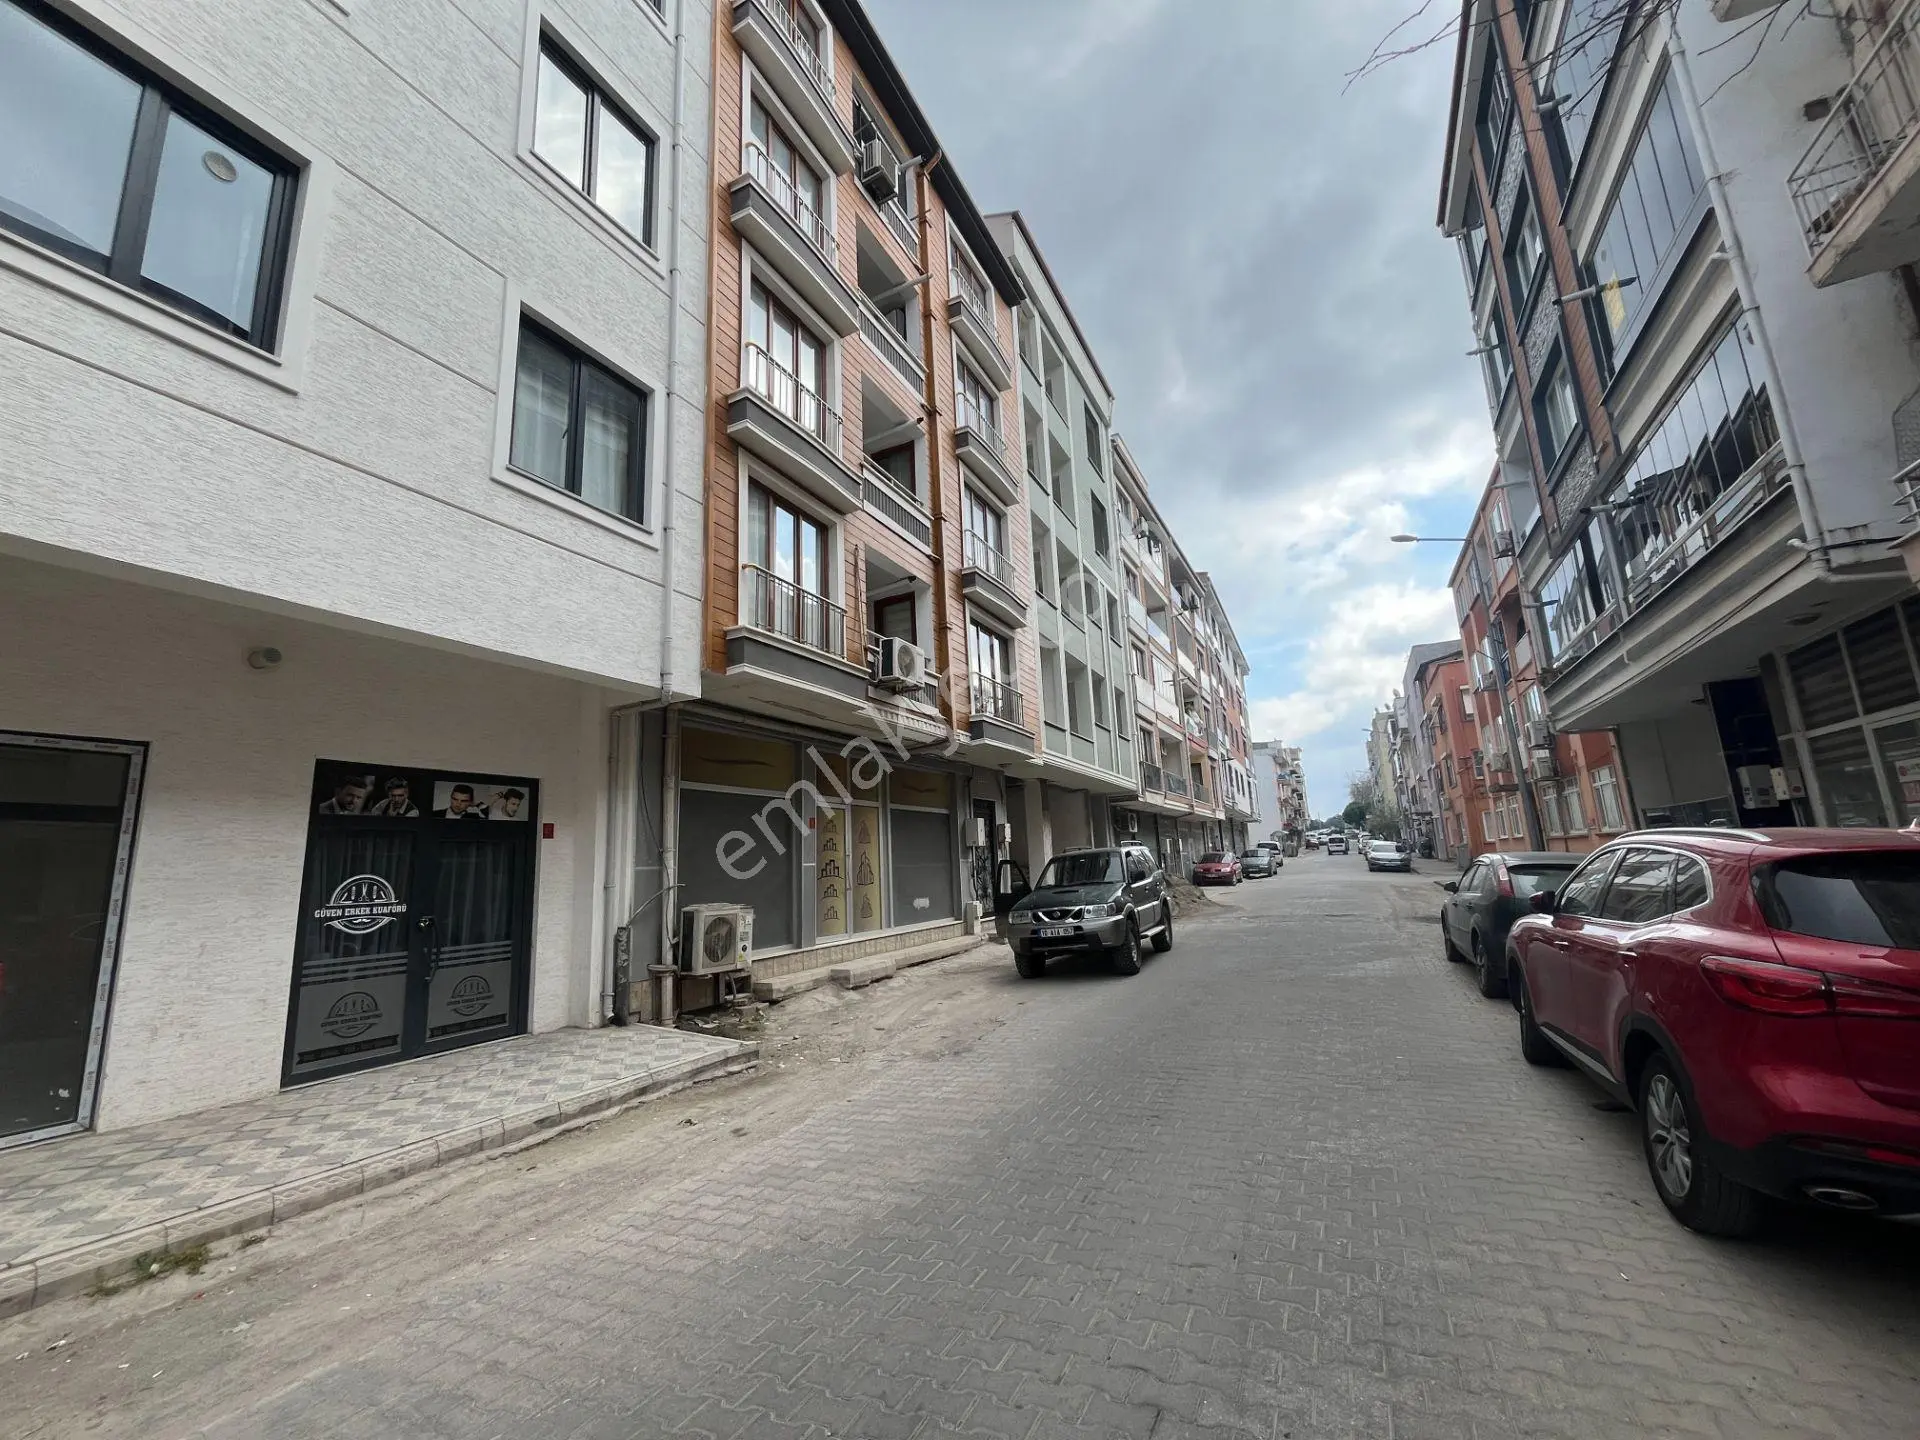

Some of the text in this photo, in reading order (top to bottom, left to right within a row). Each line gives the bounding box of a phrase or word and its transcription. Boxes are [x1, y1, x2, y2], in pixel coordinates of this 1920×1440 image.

[314, 904, 407, 918] GÜVEN ERKEK KUAFÖRÜ
